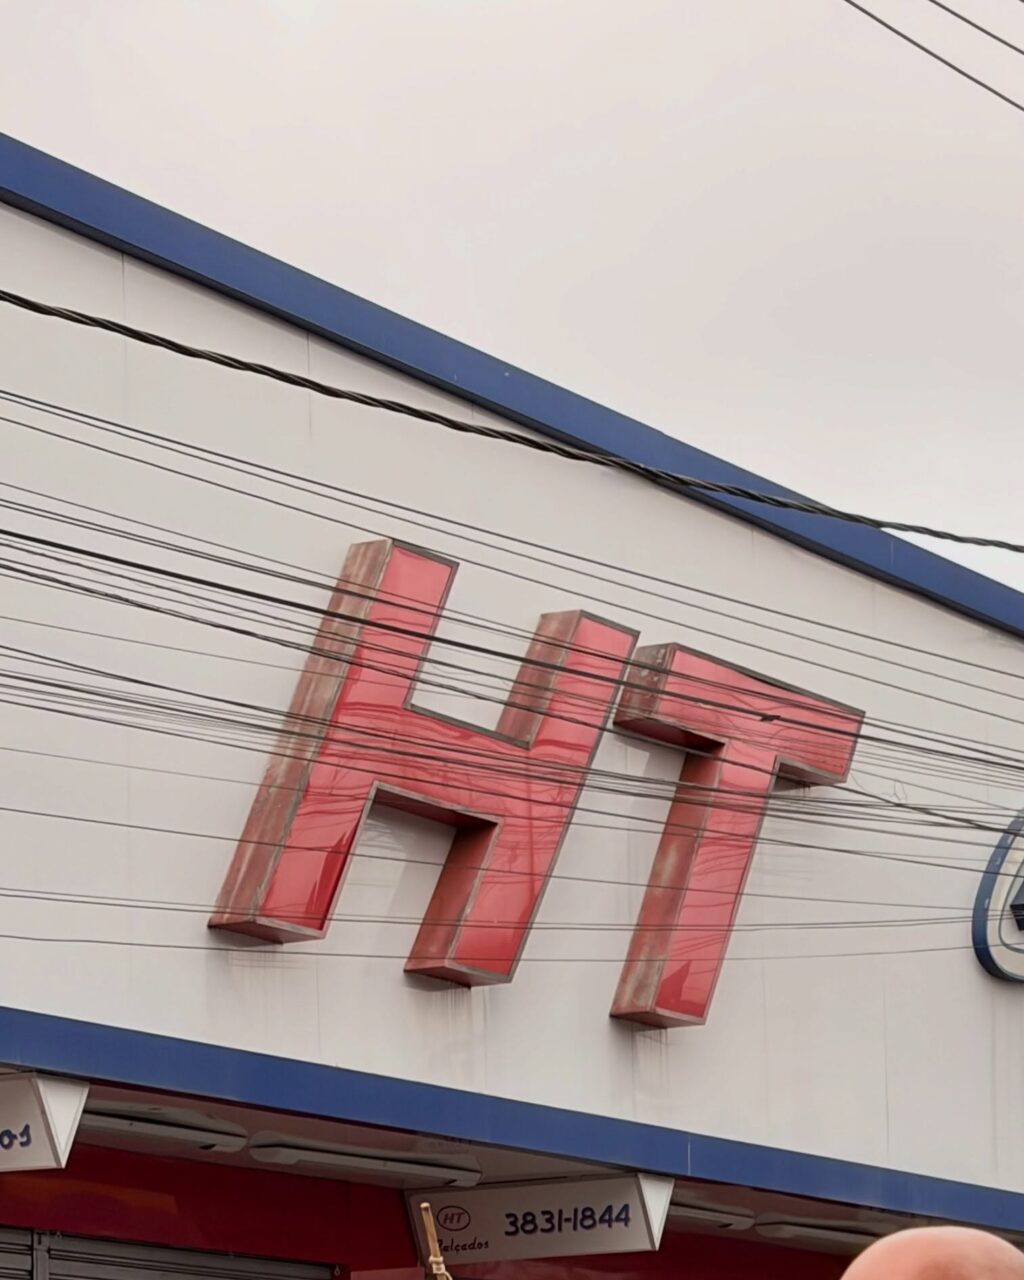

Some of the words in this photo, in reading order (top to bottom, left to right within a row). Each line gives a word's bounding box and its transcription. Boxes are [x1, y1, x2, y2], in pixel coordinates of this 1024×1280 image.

[207, 538, 866, 1027] HT
[443, 1211, 466, 1225] HT
[504, 1203, 631, 1236] 3831-1844
